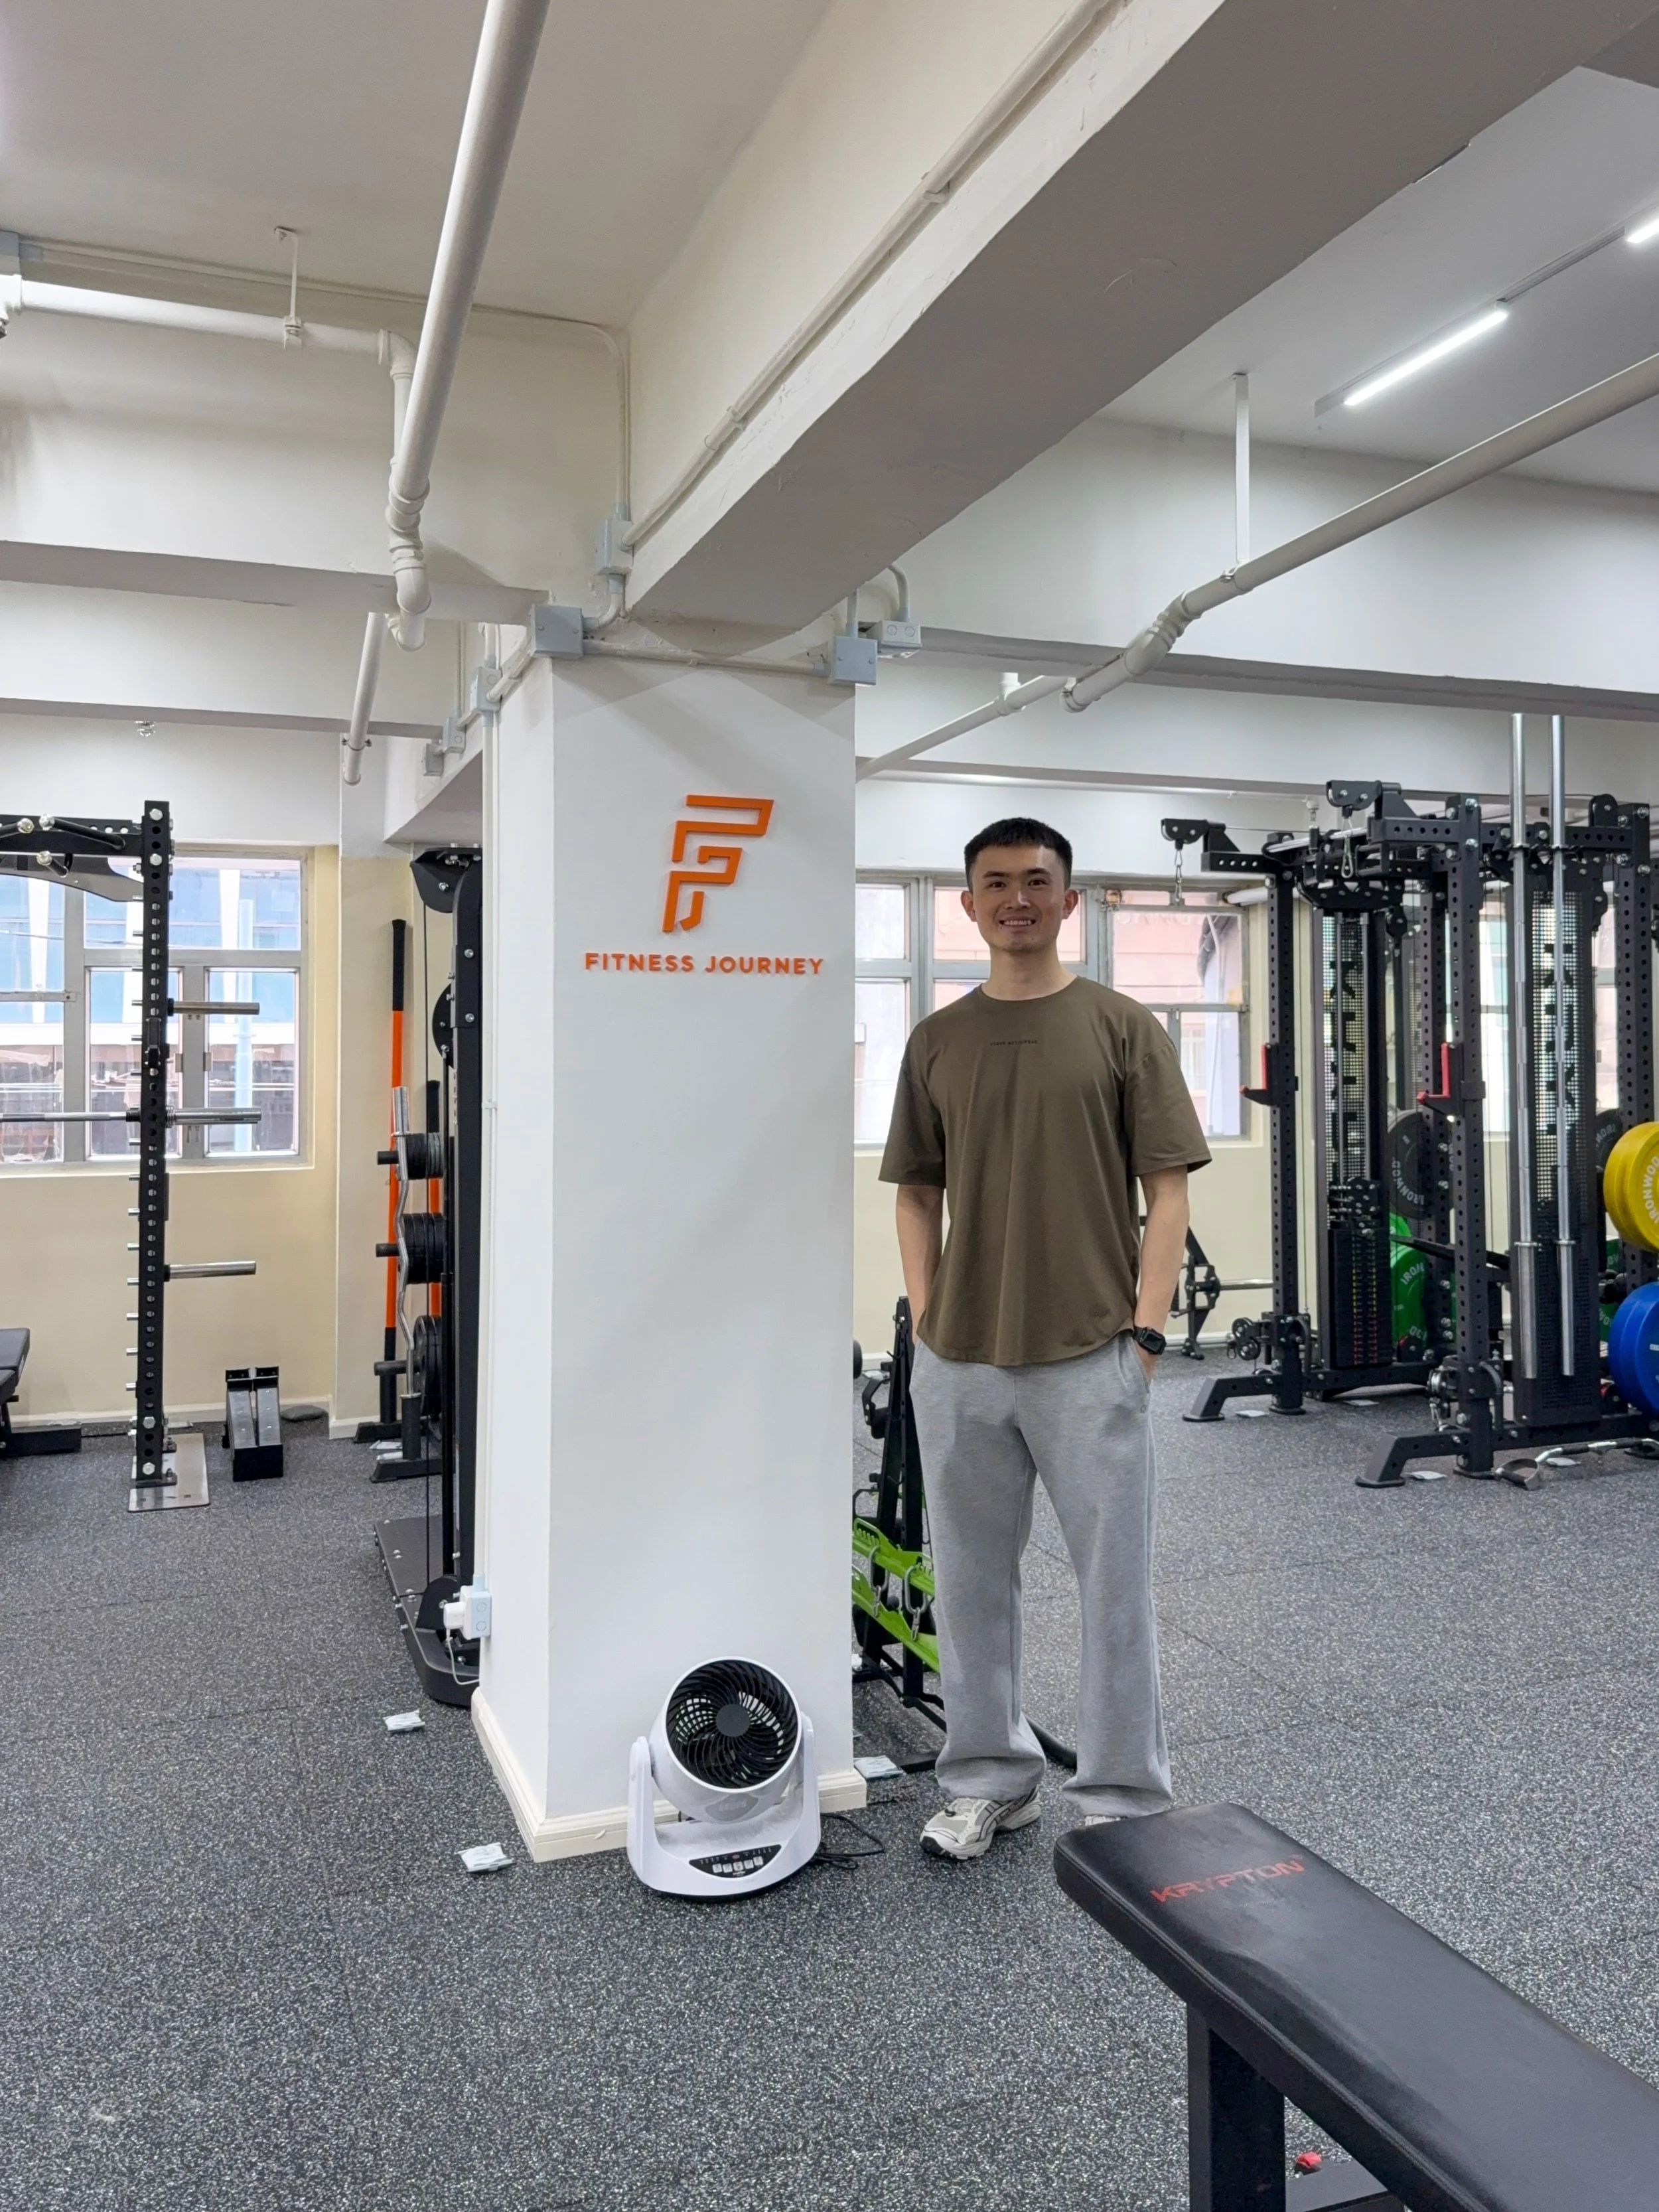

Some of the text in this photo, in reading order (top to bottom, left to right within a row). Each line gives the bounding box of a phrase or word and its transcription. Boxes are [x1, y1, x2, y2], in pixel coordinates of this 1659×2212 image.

[585, 952, 824, 974] FITNESS JOURNEY
[1150, 1860, 1305, 1903] KRYPTON
